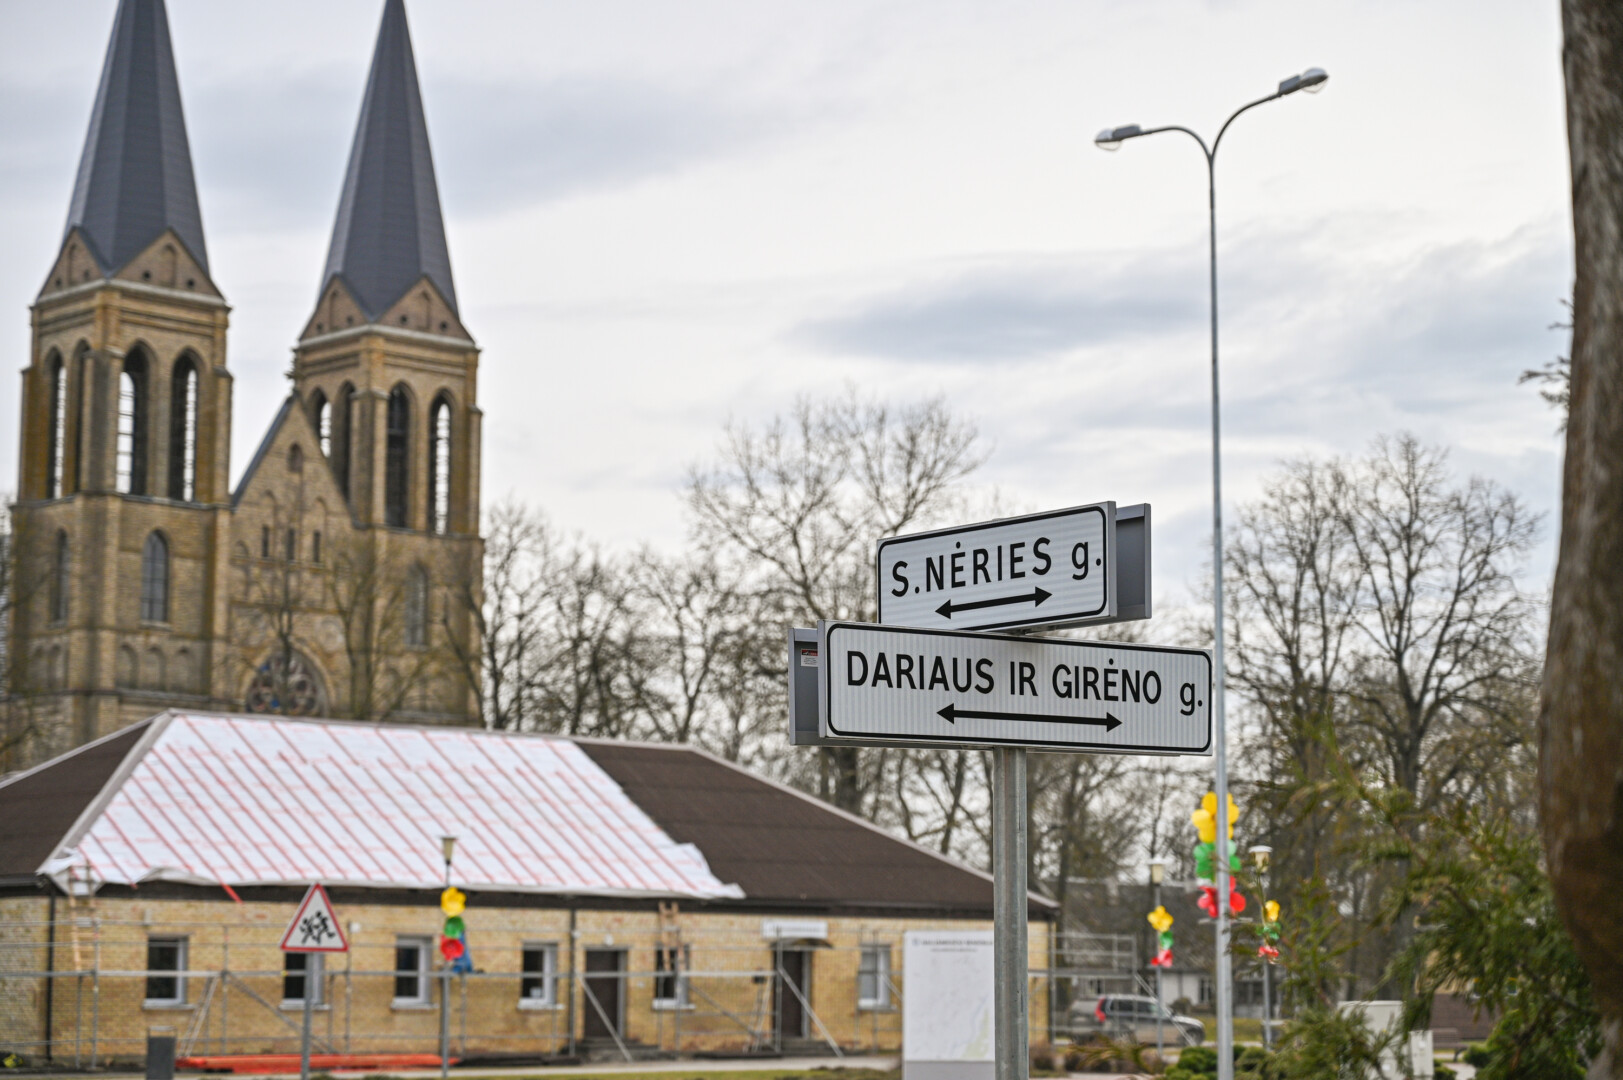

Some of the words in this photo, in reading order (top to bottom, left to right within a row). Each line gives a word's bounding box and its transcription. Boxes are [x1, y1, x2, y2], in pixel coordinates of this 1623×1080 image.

[891, 536, 1052, 598] S.NĖRIES
[1071, 541, 1102, 581] g.
[846, 650, 995, 699] DARIAUS
[1009, 660, 1039, 697] IR
[1051, 657, 1162, 705] GIRĖNO
[1179, 682, 1203, 717] g.
